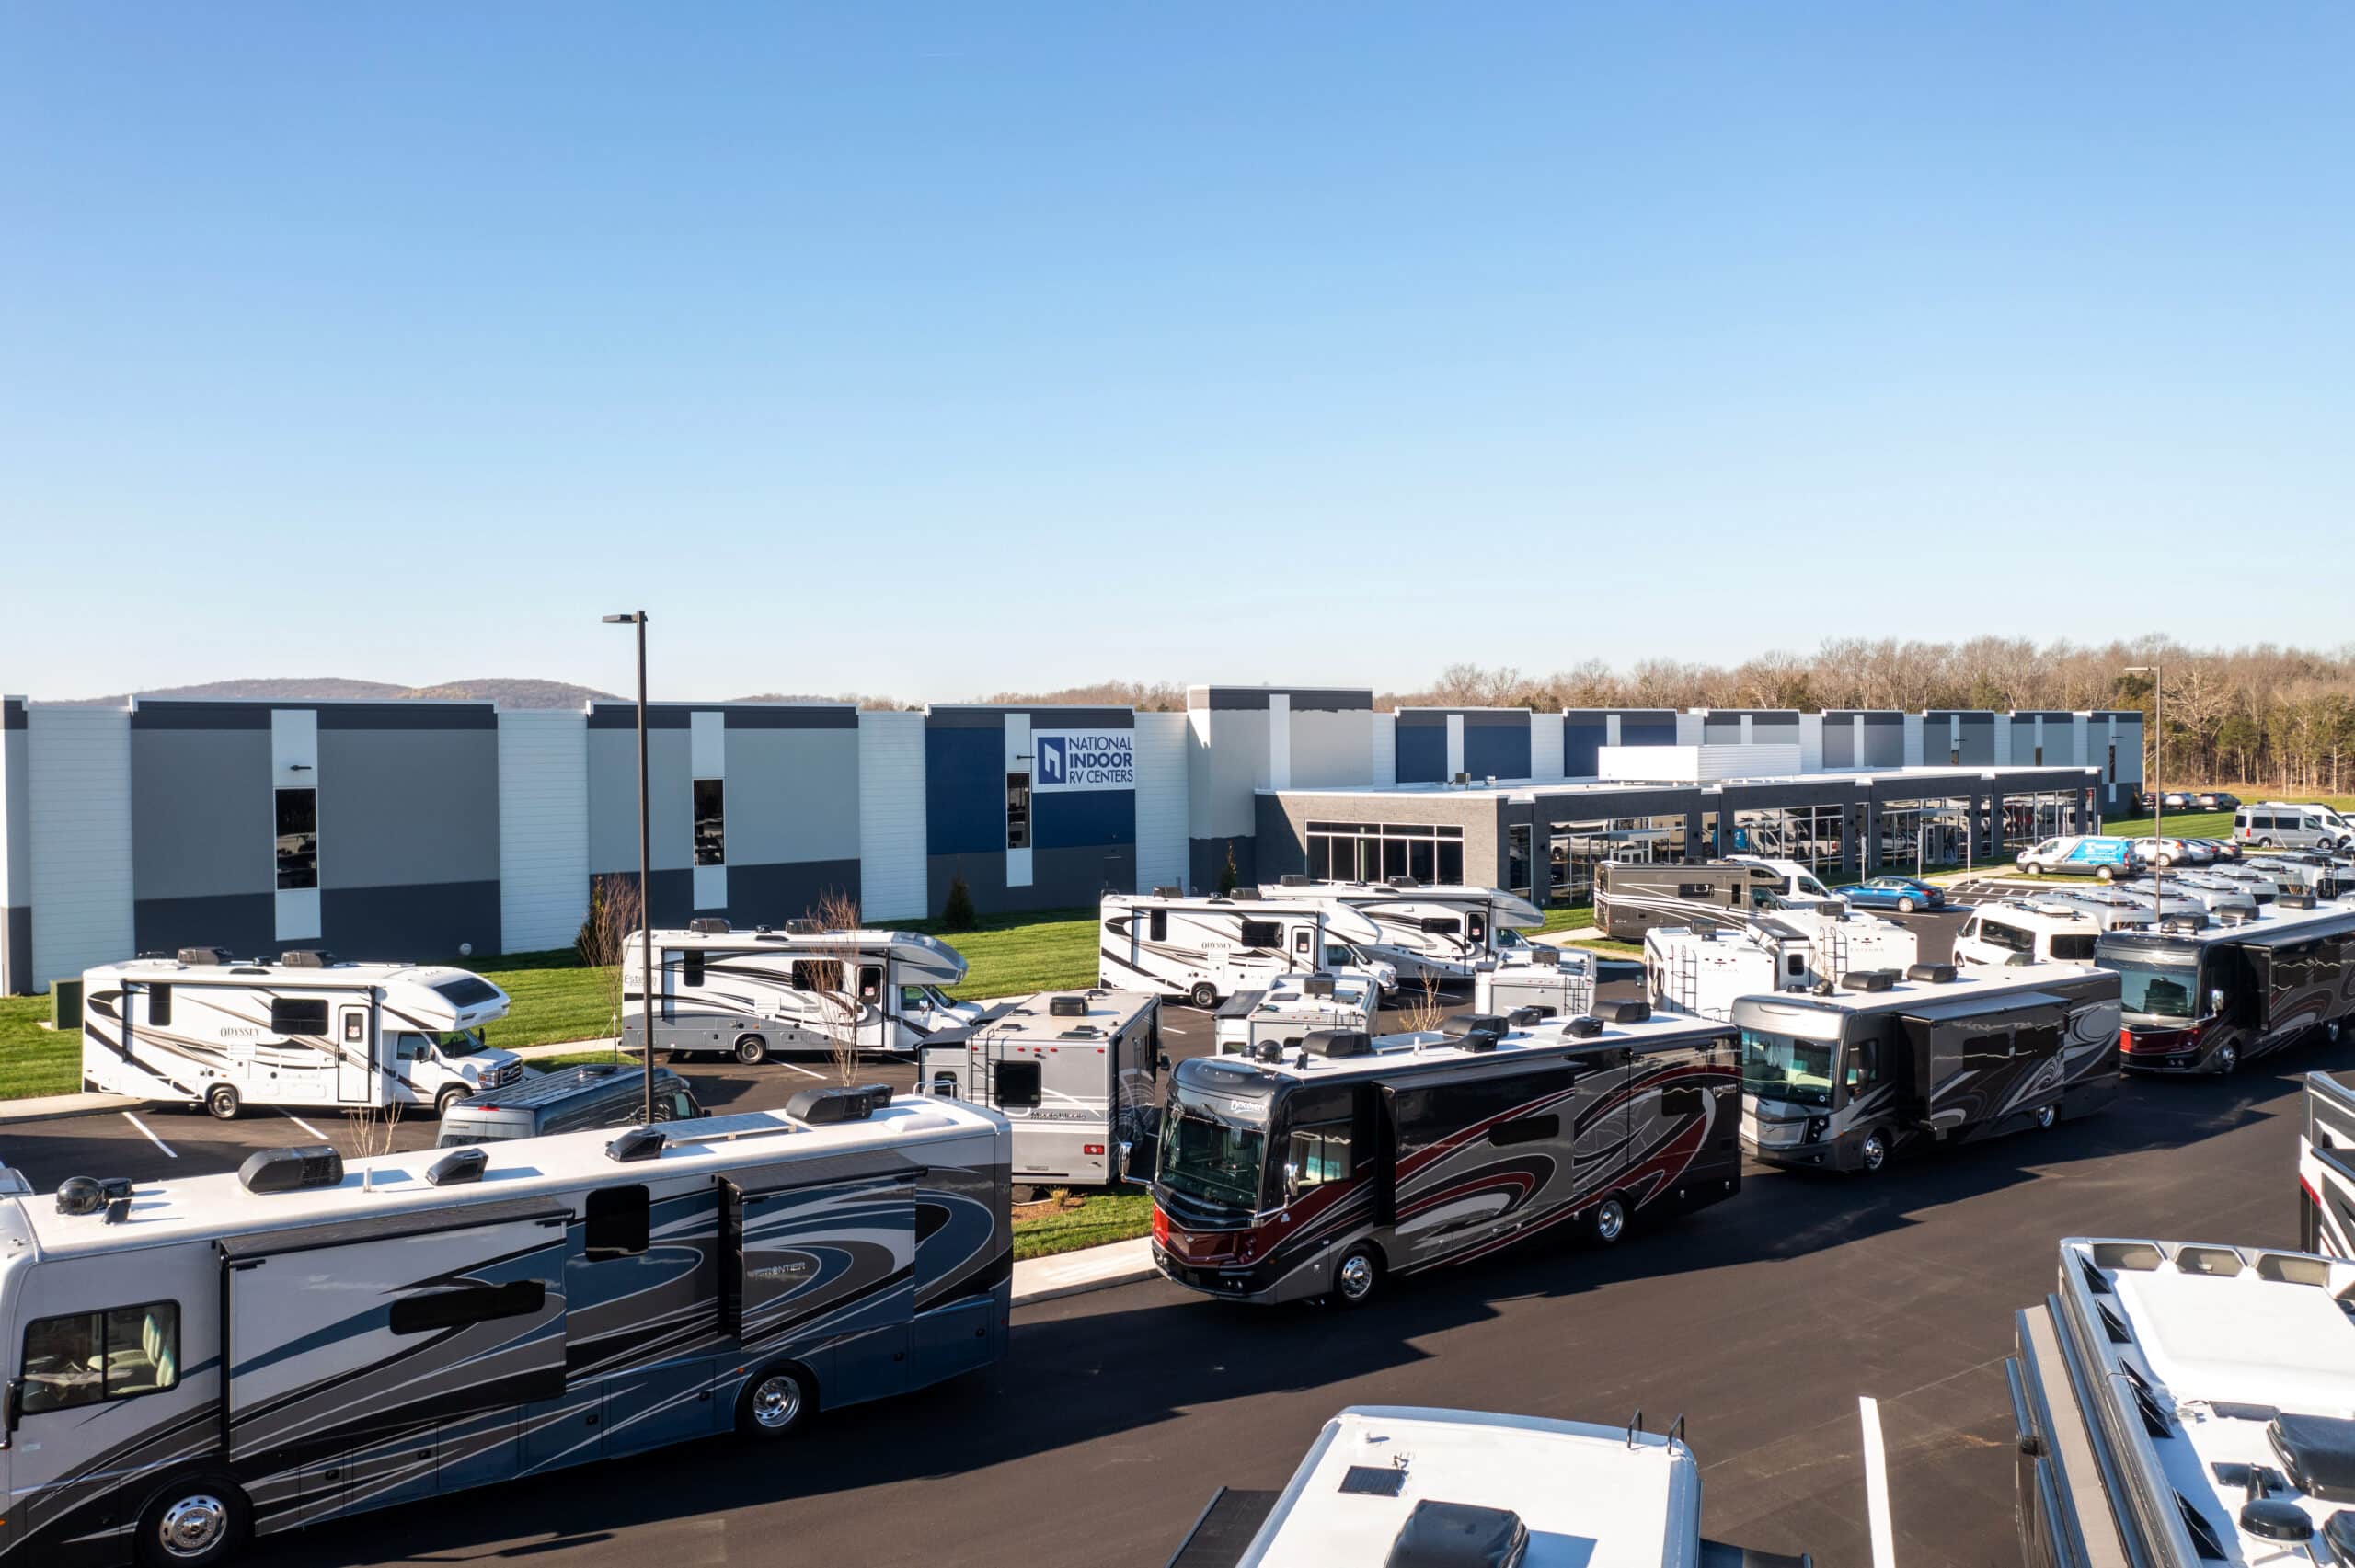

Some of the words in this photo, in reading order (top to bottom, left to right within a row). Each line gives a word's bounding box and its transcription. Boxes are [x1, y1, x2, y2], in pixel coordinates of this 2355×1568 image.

[1069, 736, 1132, 750] NATIONAL
[1069, 752, 1132, 768] INDOOR
[1069, 771, 1084, 784] RV
[1086, 770, 1133, 784] CENTERS
[220, 1025, 259, 1037] ODYSSEY
